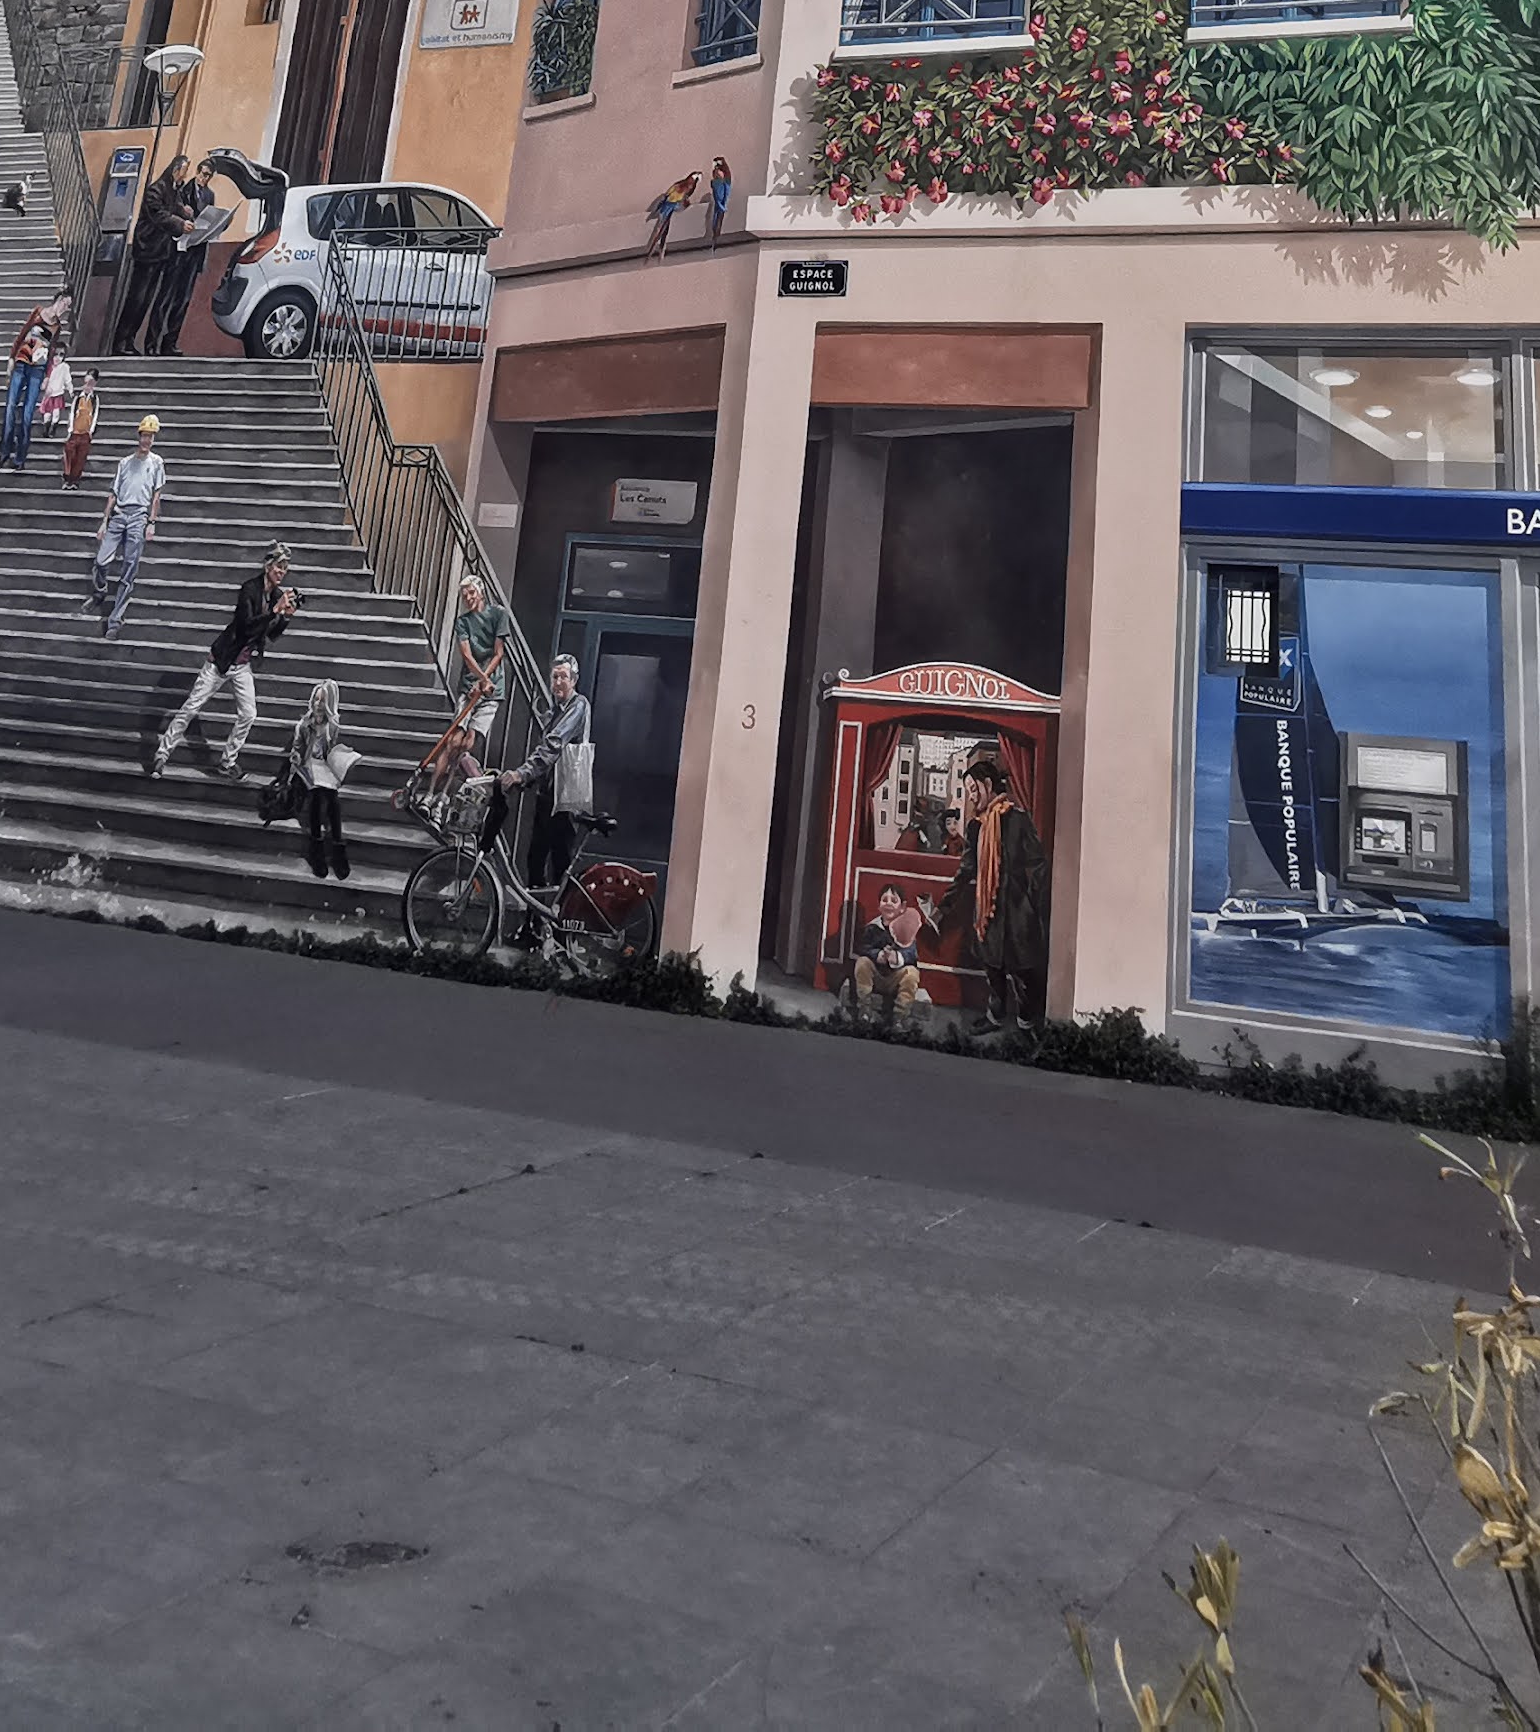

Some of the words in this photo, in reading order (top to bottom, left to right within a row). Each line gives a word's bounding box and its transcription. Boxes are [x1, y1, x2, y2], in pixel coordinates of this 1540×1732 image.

[789, 281, 835, 291] GUIGNOL
[792, 269, 834, 279] ESPACE
[899, 669, 1011, 700] GUIGNOL
[742, 704, 756, 730] 3
[1276, 719, 1294, 791] BANQUE
[1282, 795, 1301, 891] POPULAIRE
